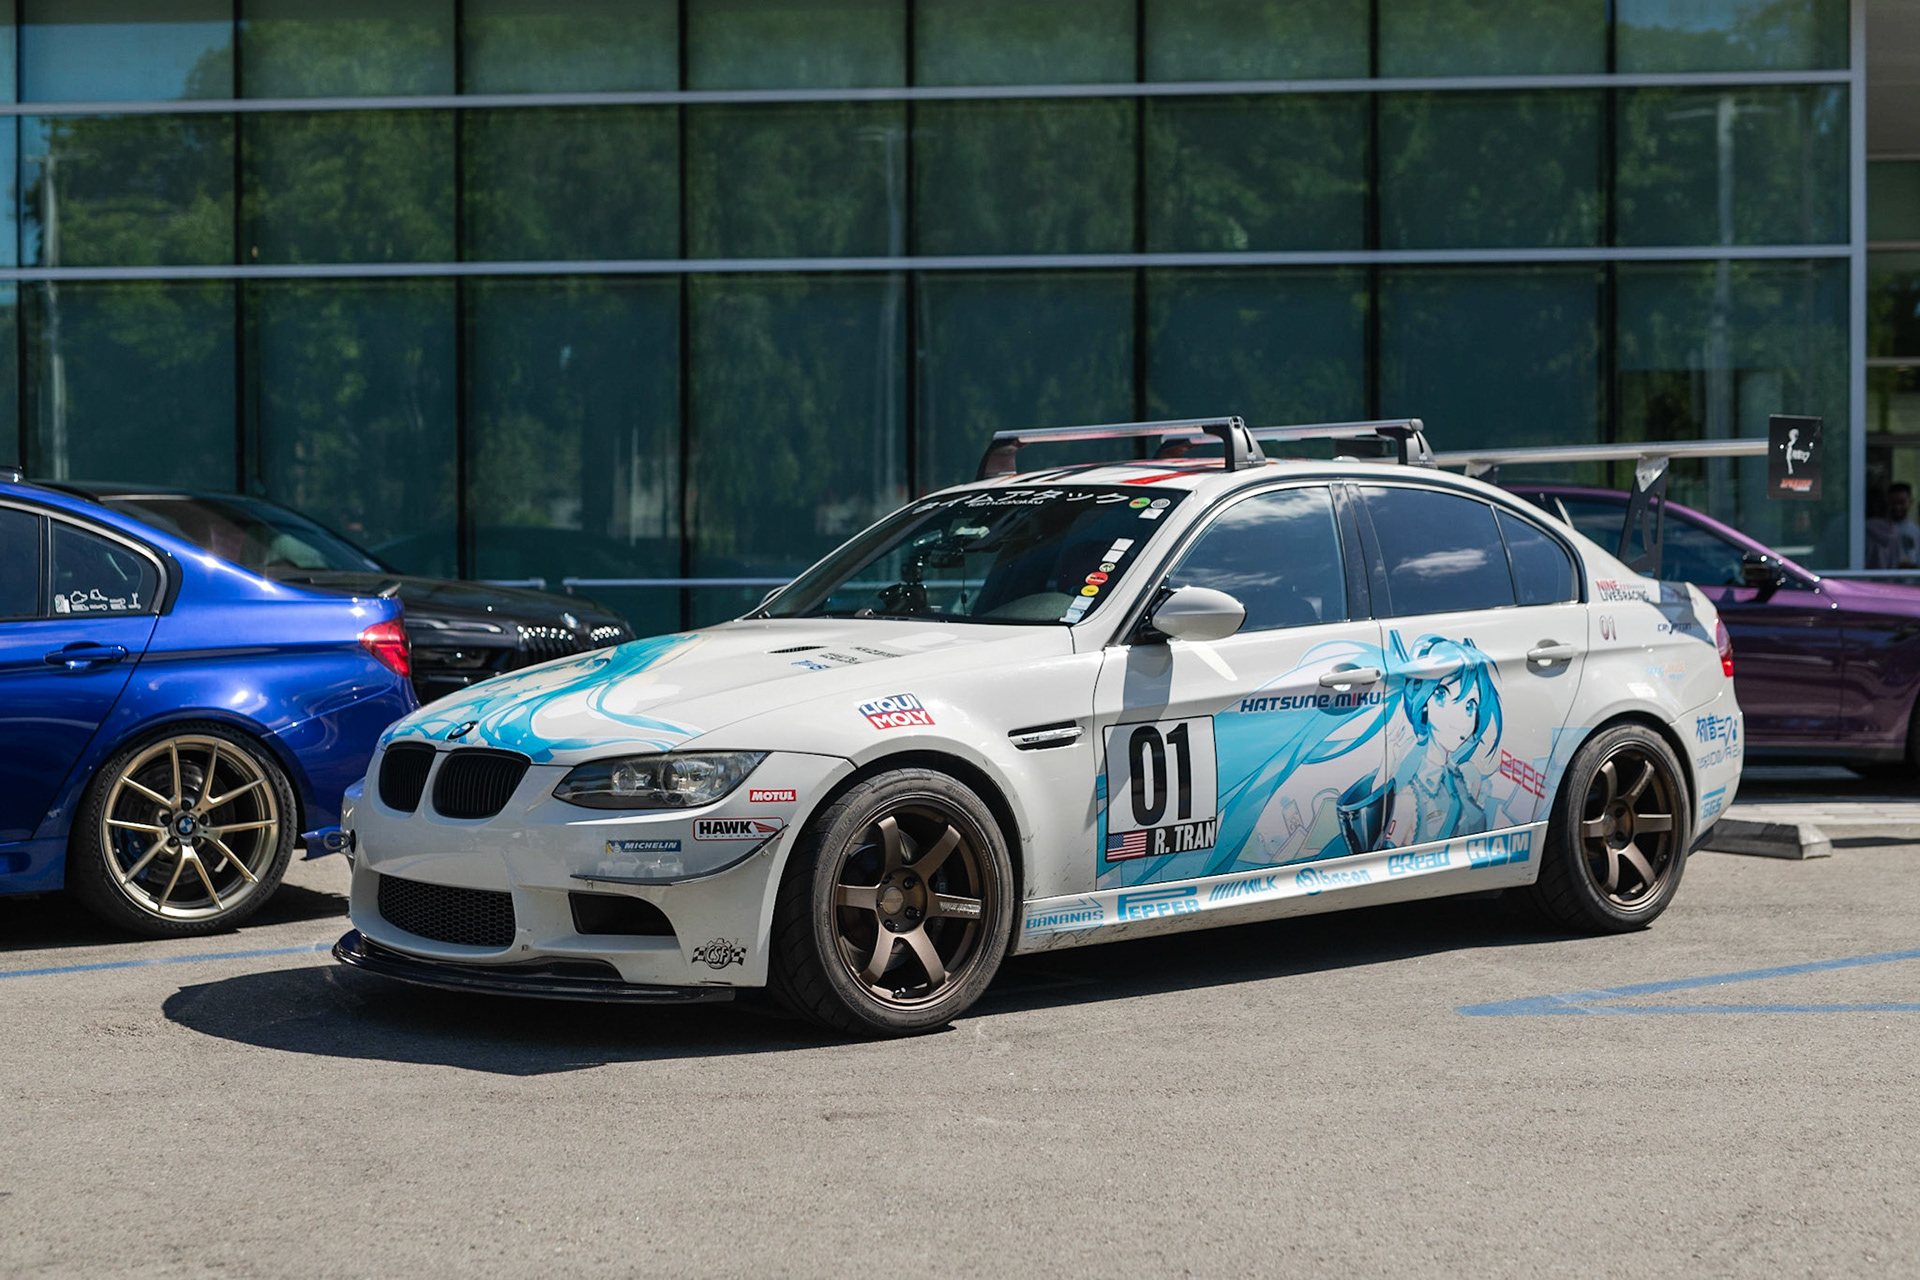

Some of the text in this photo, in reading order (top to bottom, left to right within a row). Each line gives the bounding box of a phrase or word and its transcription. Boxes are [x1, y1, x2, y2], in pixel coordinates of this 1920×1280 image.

[1600, 615, 1616, 641] 01
[861, 694, 917, 716] LIQUI
[870, 710, 930, 729] MOLY
[1129, 722, 1192, 826] 01
[751, 791, 794, 801] MOTUL
[699, 821, 753, 834] HAWK
[1153, 821, 1216, 854] R. TRAN
[624, 841, 678, 850] MICHELIN
[1025, 910, 1104, 929] BANANAS
[1117, 885, 1202, 922] PEPPER
[1319, 868, 1372, 886] bacon
[1468, 832, 1530, 862] HAM
[707, 946, 729, 964] CSF
